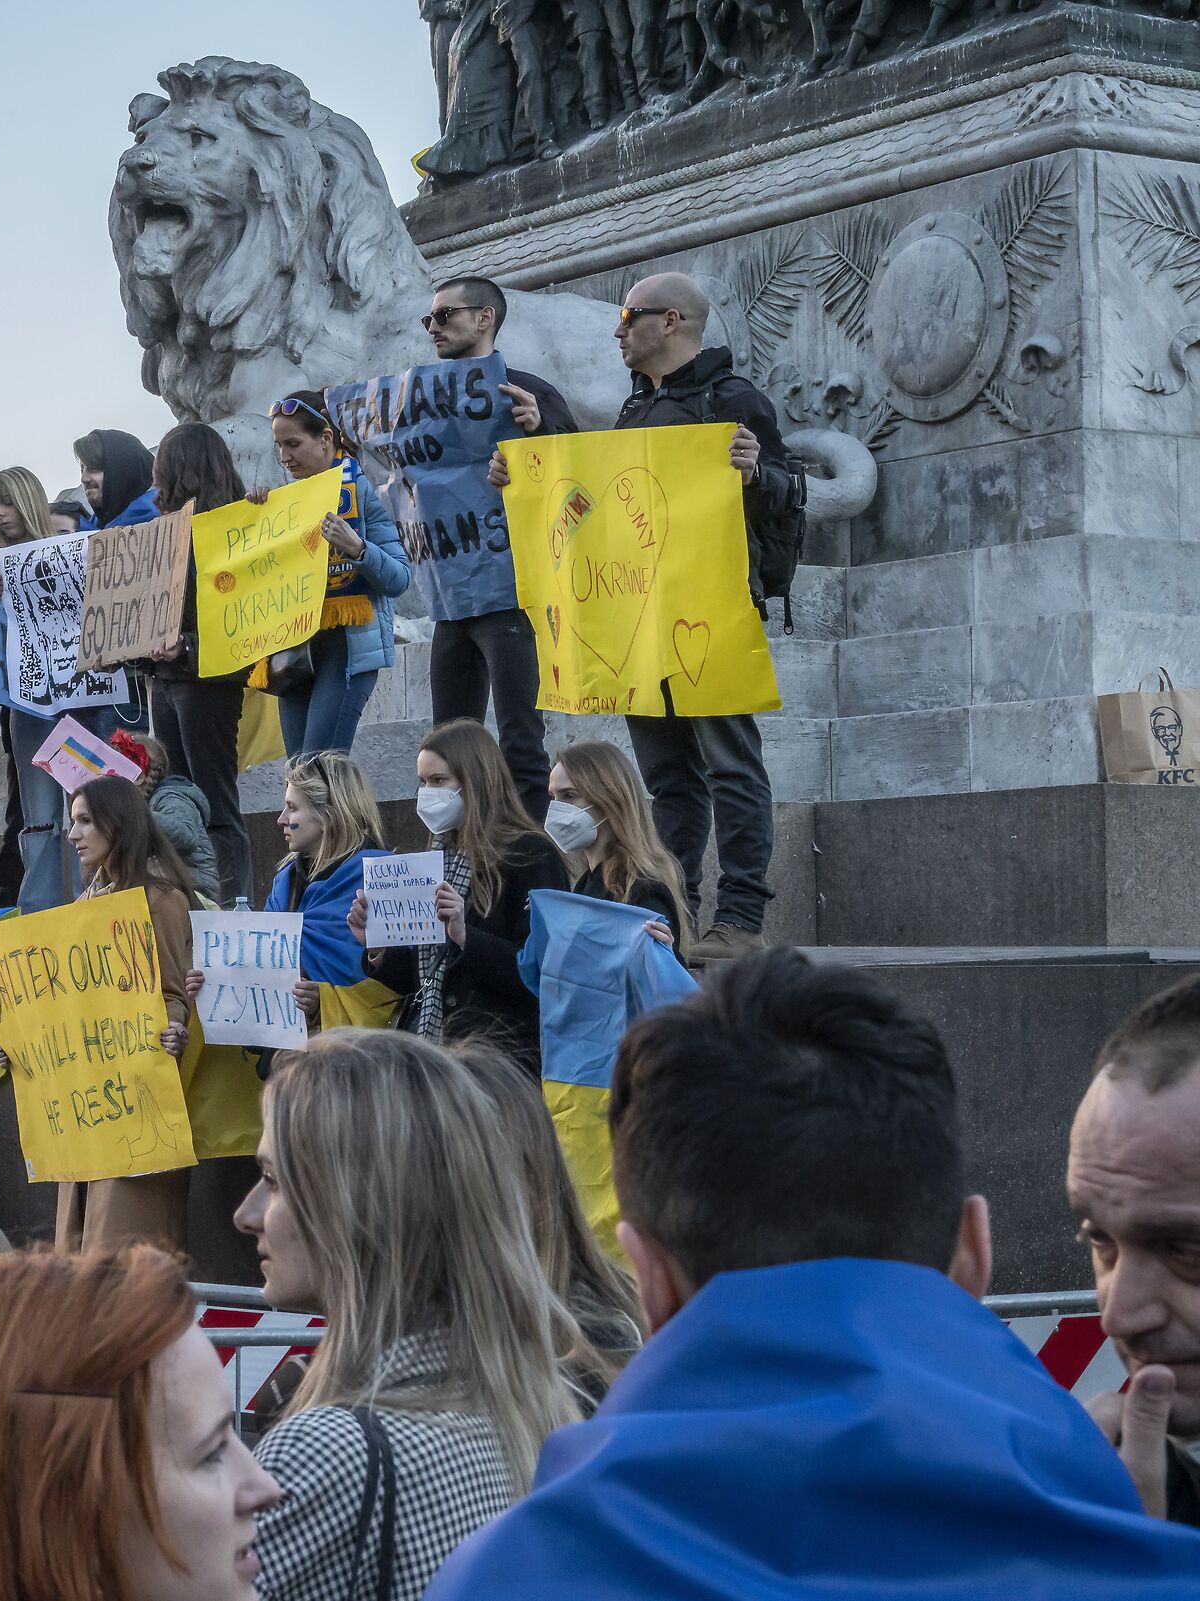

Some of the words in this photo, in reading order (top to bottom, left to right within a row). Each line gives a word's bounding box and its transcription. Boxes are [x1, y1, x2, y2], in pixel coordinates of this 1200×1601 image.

[226, 501, 302, 560] PEACE
[616, 477, 656, 549] SUMY
[89, 521, 167, 595] RUSSIAN
[248, 551, 281, 580] FOR
[82, 605, 107, 660] GO
[108, 595, 146, 652] FUCK
[1157, 769, 1195, 785] KFC
[365, 860, 410, 880] РУССКИЙ
[403, 877, 437, 888] КОРАБЛЬ
